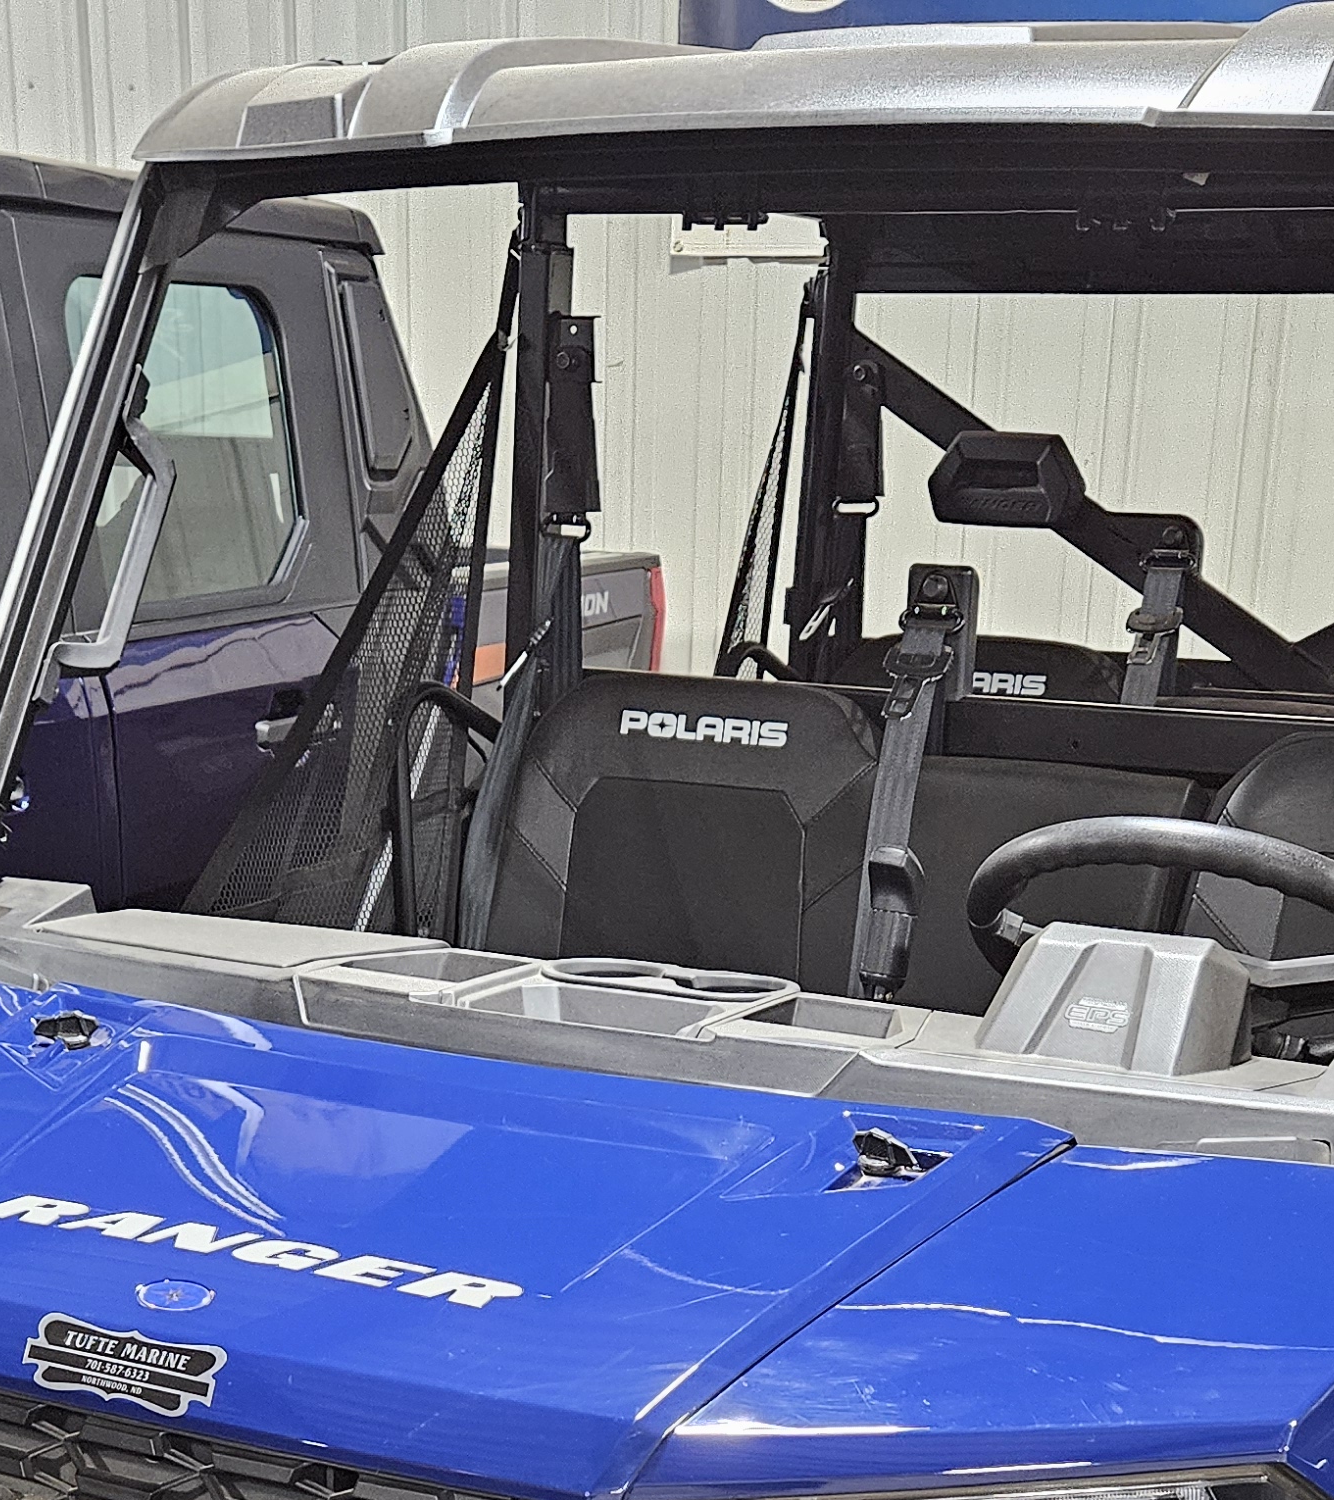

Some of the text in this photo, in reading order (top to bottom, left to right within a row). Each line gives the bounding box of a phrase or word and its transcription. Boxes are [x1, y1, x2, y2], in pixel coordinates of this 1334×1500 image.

[620, 709, 789, 748] POLARIS
[1064, 1003, 1131, 1028] EPS
[64, 1329, 191, 1371] TUFTE MARINE
[84, 1358, 151, 1382] 701-587-6323
[80, 1374, 143, 1395] NORTHWOOD, ND
